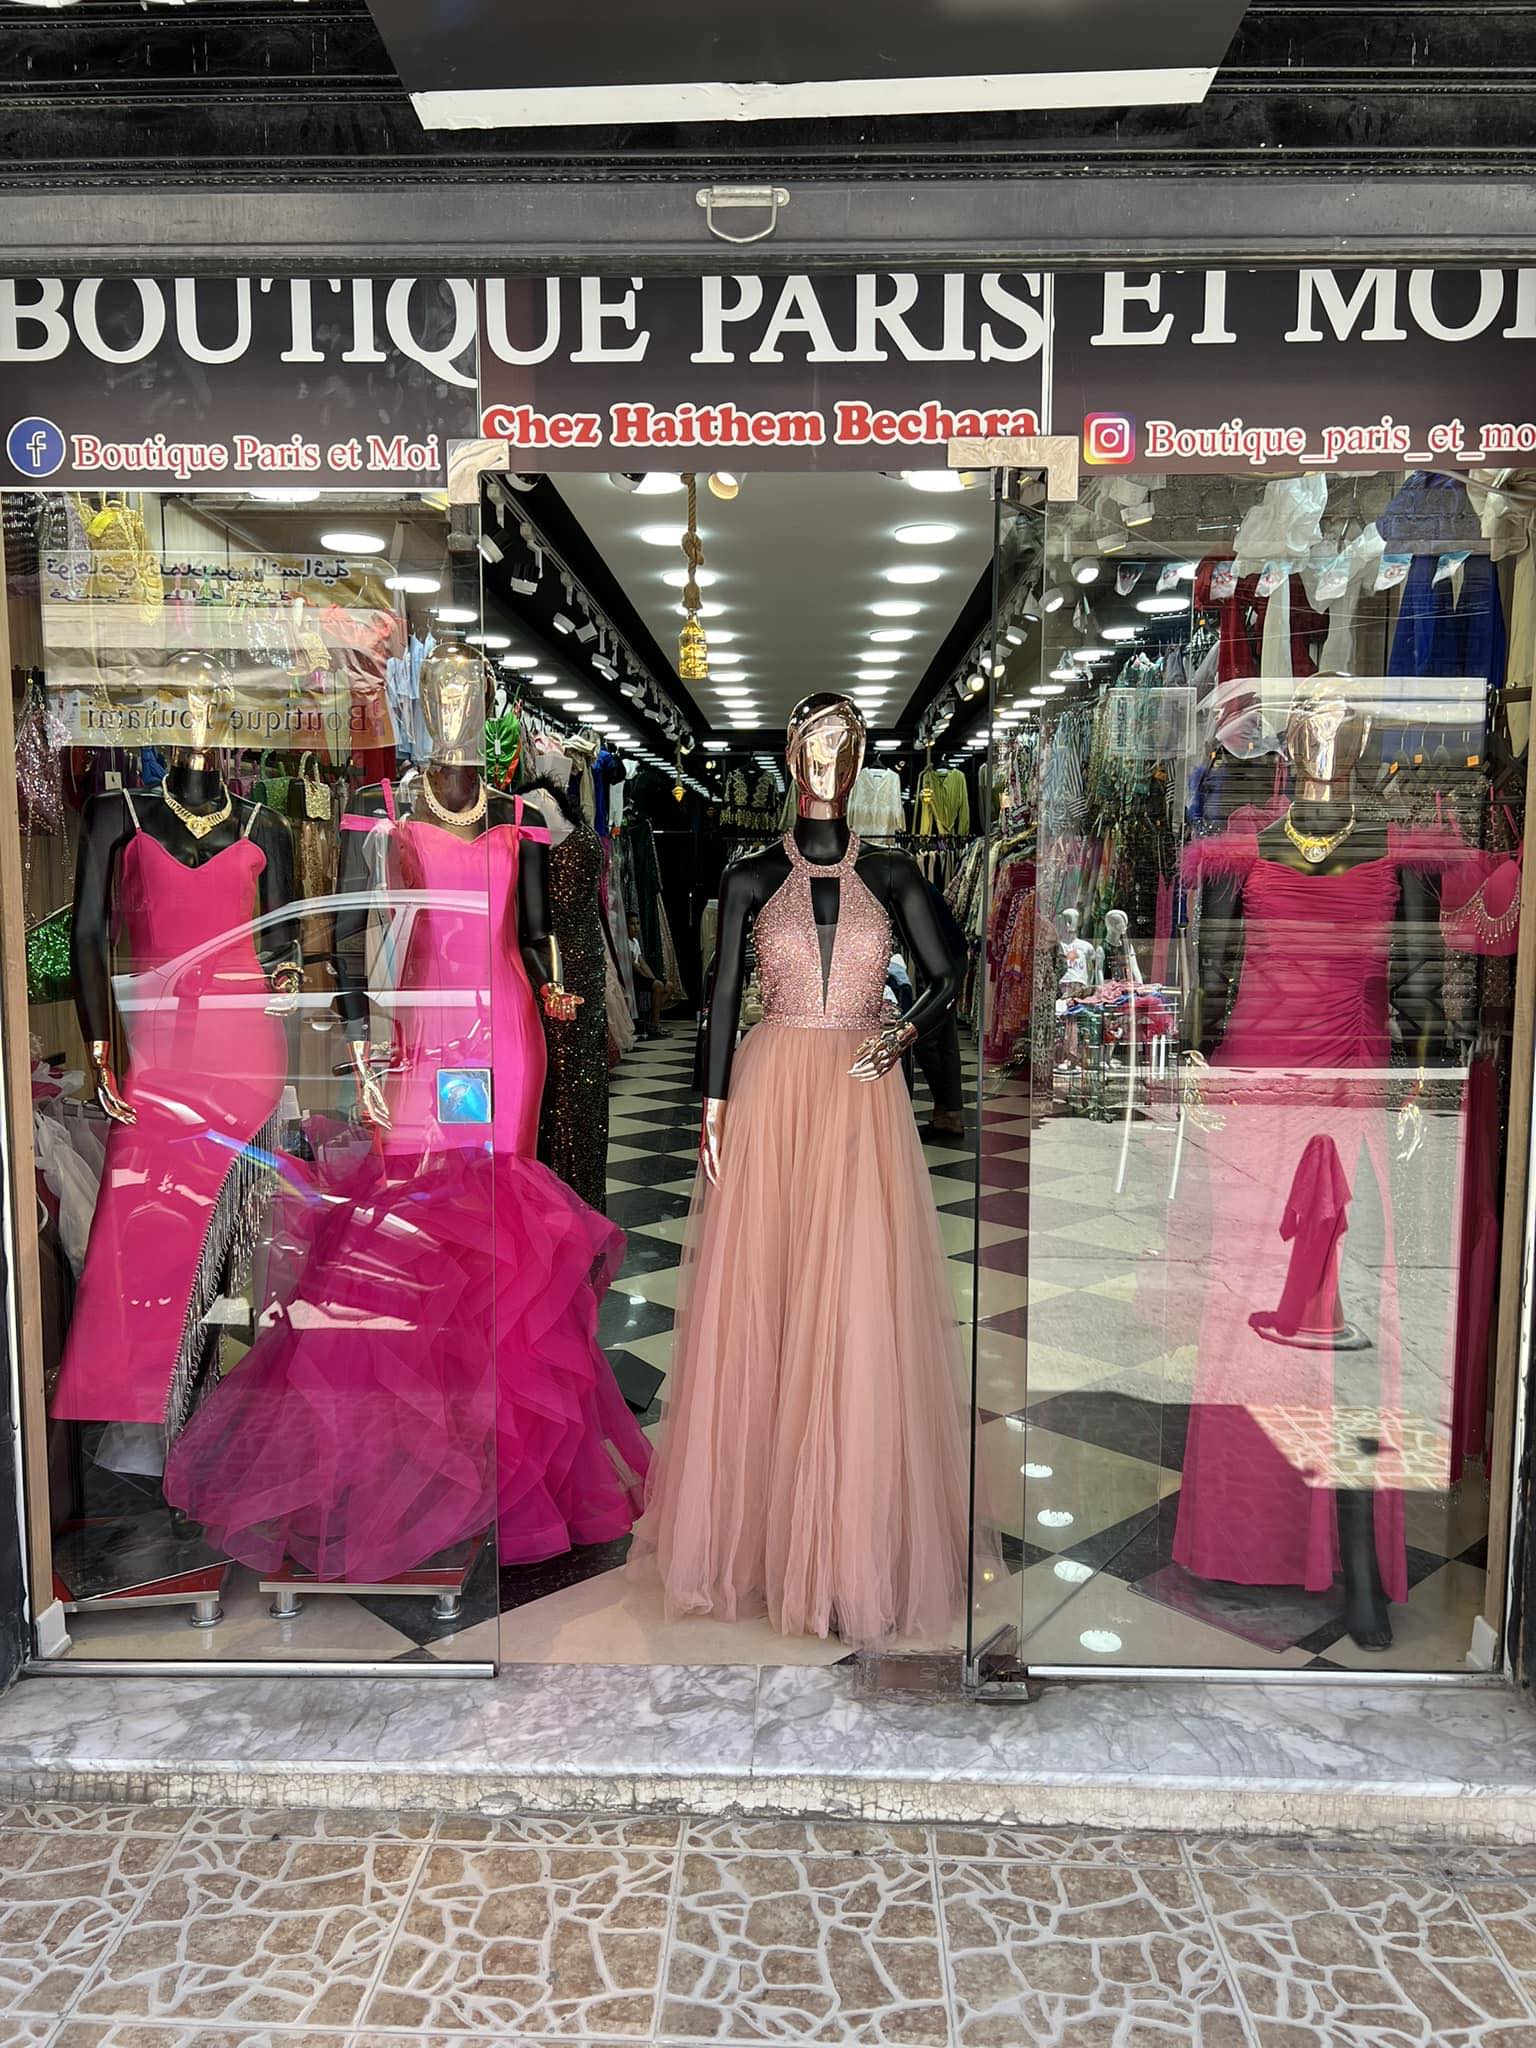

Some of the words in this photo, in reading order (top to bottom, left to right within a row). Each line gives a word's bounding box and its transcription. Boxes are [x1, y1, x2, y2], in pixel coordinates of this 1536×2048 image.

[0, 277, 651, 389] BOUTIQUE
[690, 273, 1043, 363] PARIS
[1090, 270, 1237, 345] ET
[480, 404, 601, 448] Chez
[609, 402, 826, 448] Haithem
[833, 400, 1041, 445] Bechara
[71, 434, 228, 479] Boutique
[233, 434, 321, 470] Paris
[327, 437, 363, 470] et
[366, 434, 441, 470] Moi
